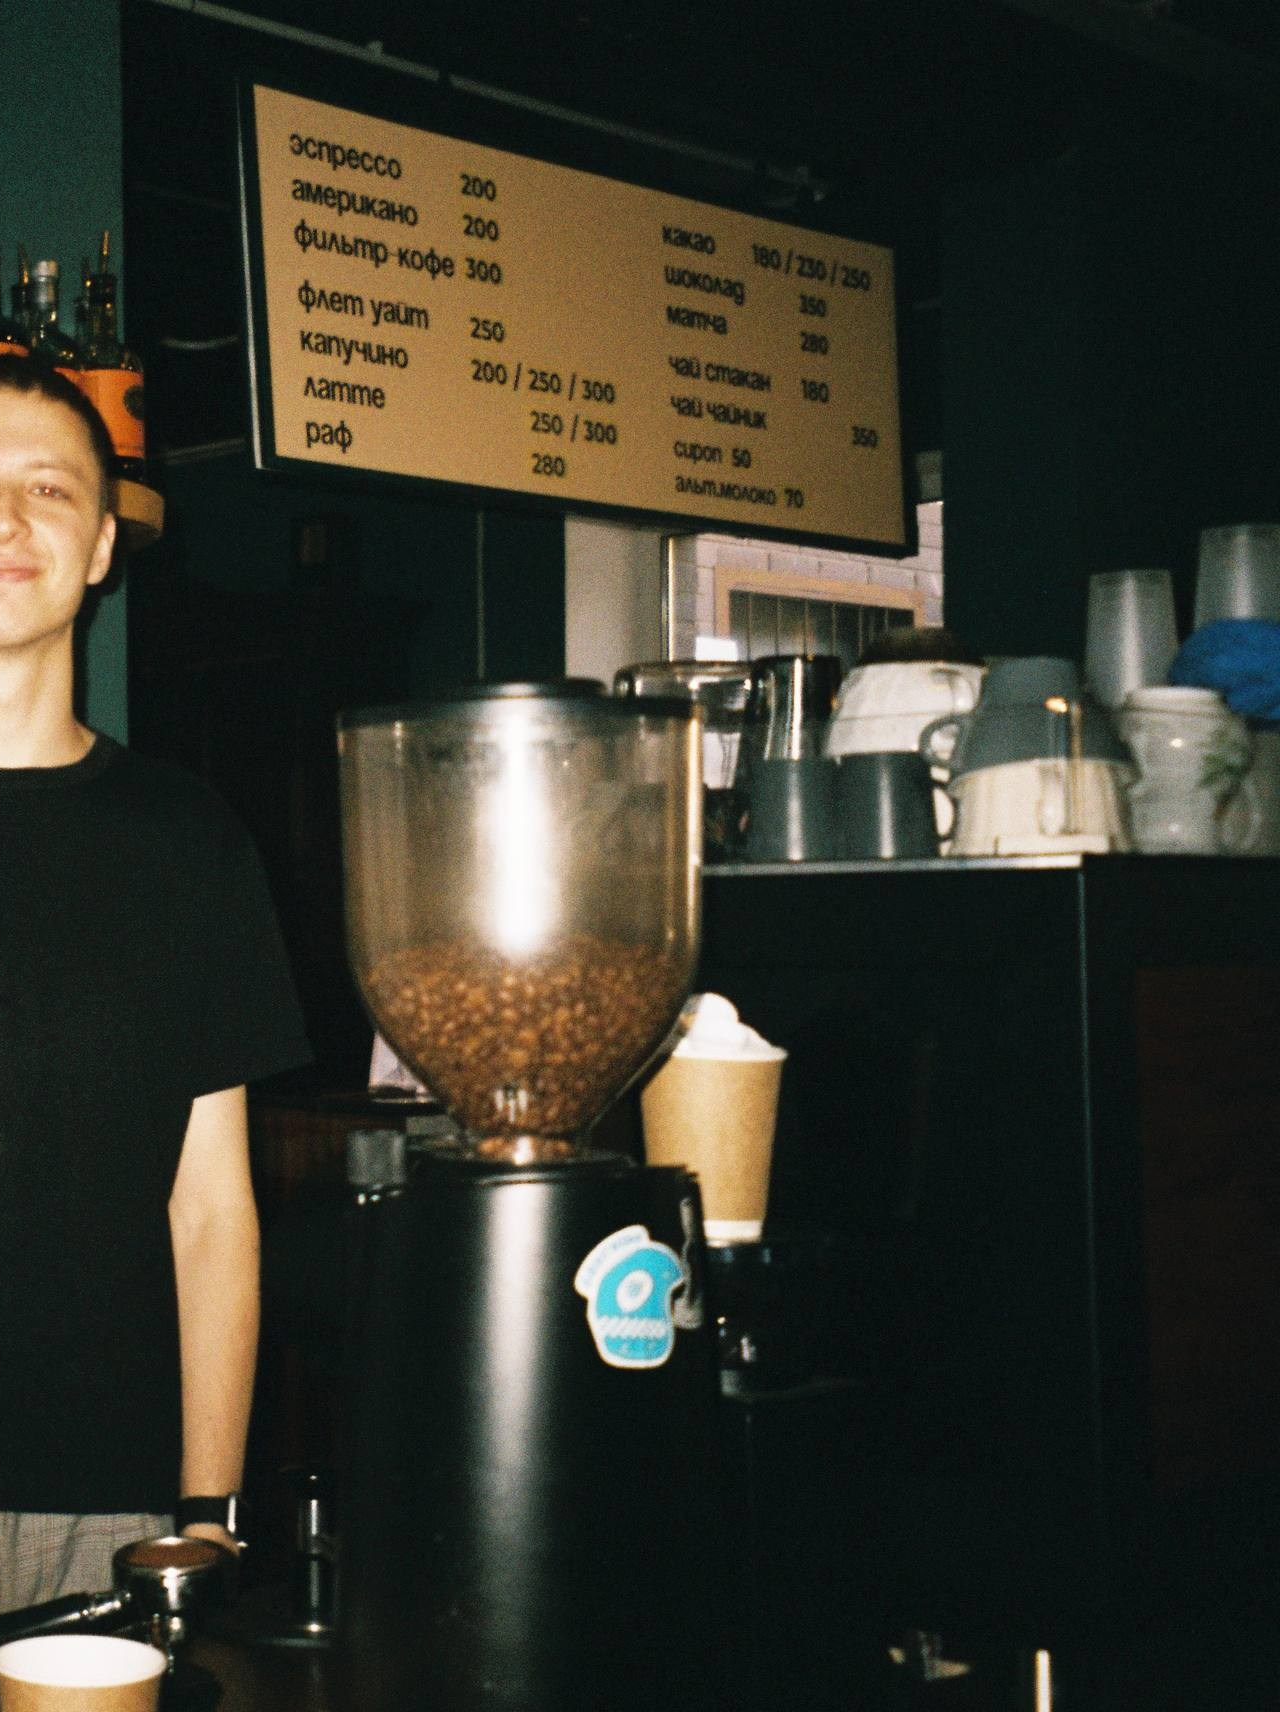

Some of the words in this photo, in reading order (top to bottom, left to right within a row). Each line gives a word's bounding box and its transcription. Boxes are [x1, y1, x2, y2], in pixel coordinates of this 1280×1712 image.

[289, 133, 403, 180] эспрессо
[459, 172, 498, 203] 200
[291, 178, 419, 227] американо
[462, 213, 500, 243] 200
[465, 256, 503, 286] 300
[661, 225, 717, 256] какао
[751, 243, 782, 272] 180
[795, 254, 828, 282] 230
[840, 265, 872, 292] 250
[663, 265, 746, 306] шоколад
[297, 279, 365, 317] флет
[369, 299, 430, 330] уайт
[469, 316, 506, 344] 250
[665, 305, 729, 336] матча
[799, 330, 830, 356] 280
[299, 329, 409, 370] капучино
[470, 358, 508, 386] 200
[527, 368, 563, 395] 250
[581, 379, 616, 405] 300
[668, 355, 702, 380] чай
[704, 362, 772, 392] стакан
[800, 378, 830, 404] 180
[303, 376, 386, 410] латте
[530, 410, 564, 436] 250
[583, 419, 618, 446] 300
[670, 395, 704, 419] чай
[705, 402, 768, 431] чайник
[851, 425, 879, 449] 350
[305, 419, 354, 454] раф
[531, 452, 567, 478] 280
[672, 440, 723, 465] сироп
[731, 447, 753, 470] 50
[783, 487, 805, 510] 70
